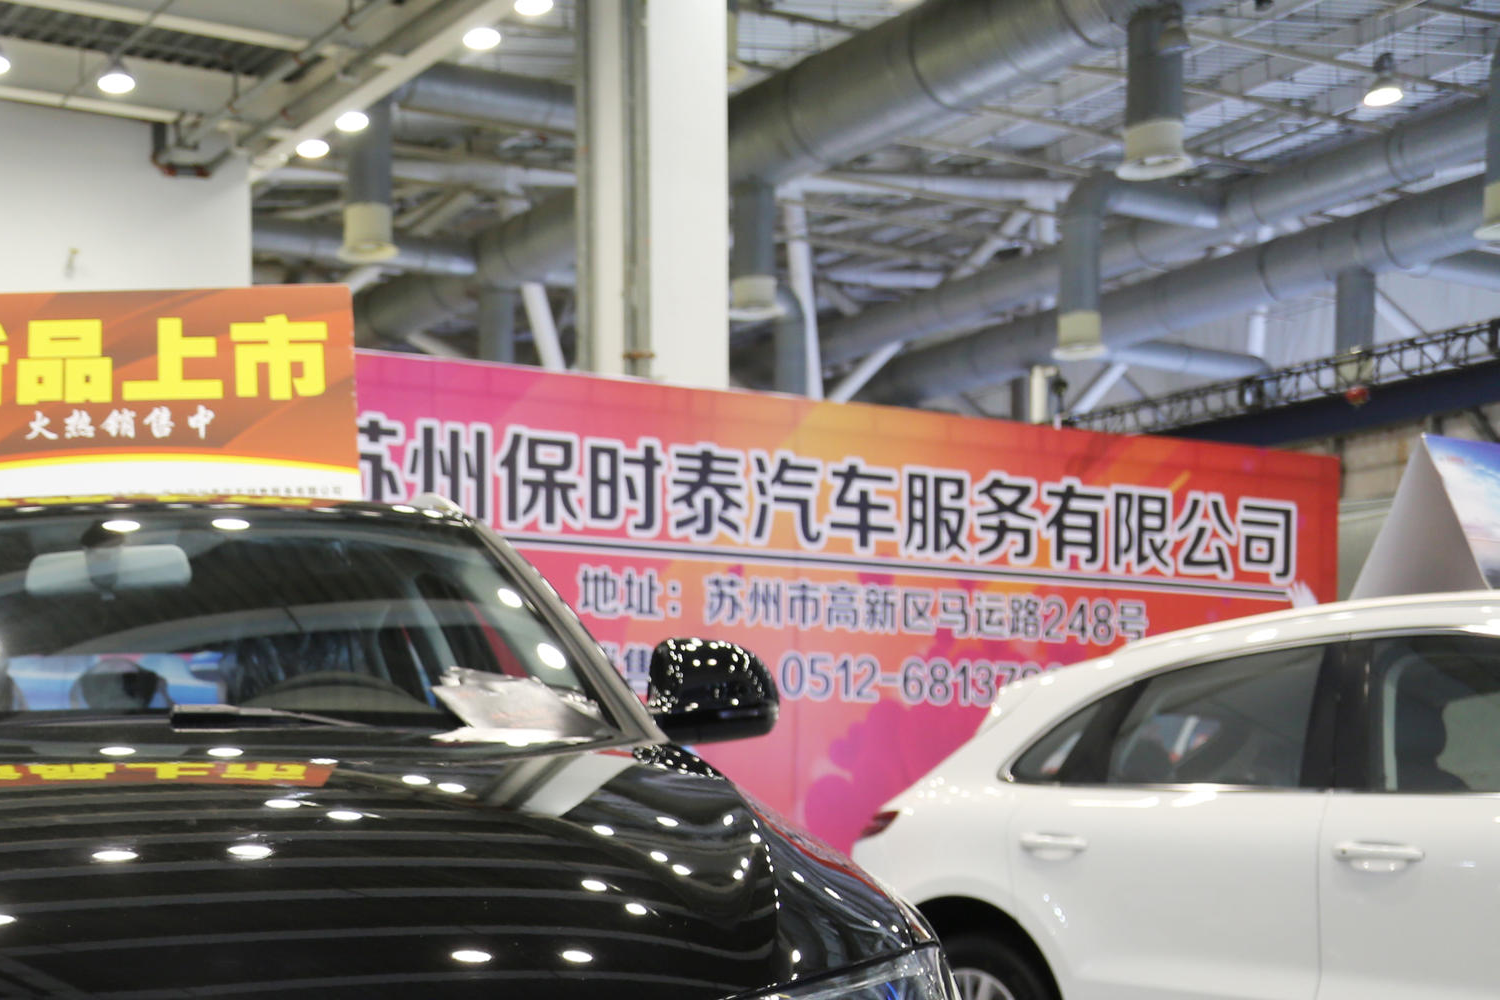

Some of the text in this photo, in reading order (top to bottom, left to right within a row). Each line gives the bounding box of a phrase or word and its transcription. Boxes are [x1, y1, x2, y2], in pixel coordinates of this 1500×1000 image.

[25, 405, 216, 441] 火热销售中
[357, 418, 1294, 578] 苏州保时泰汽车服务有限公司
